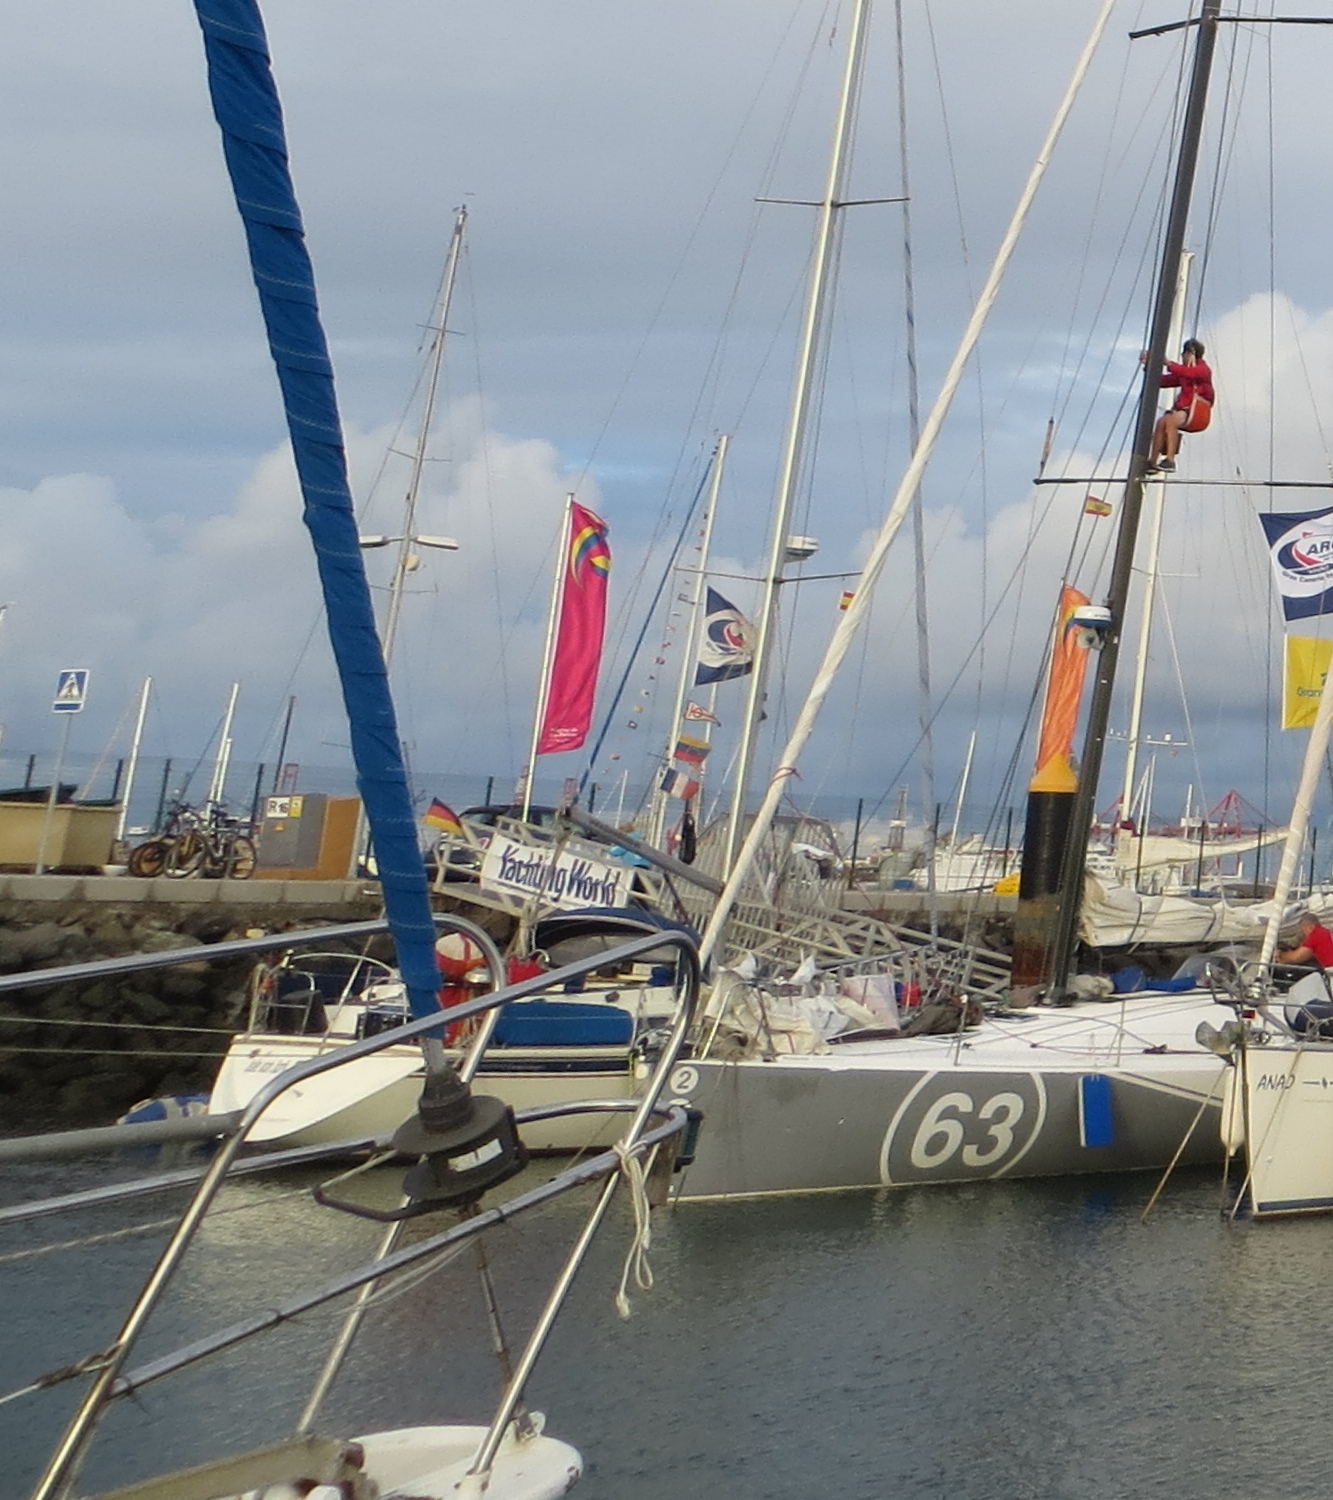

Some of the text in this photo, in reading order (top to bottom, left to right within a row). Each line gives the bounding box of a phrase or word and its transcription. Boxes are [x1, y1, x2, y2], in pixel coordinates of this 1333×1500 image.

[497, 844, 621, 907] Yachting World
[676, 1070, 692, 1089] 2
[911, 1092, 1024, 1168] 63
